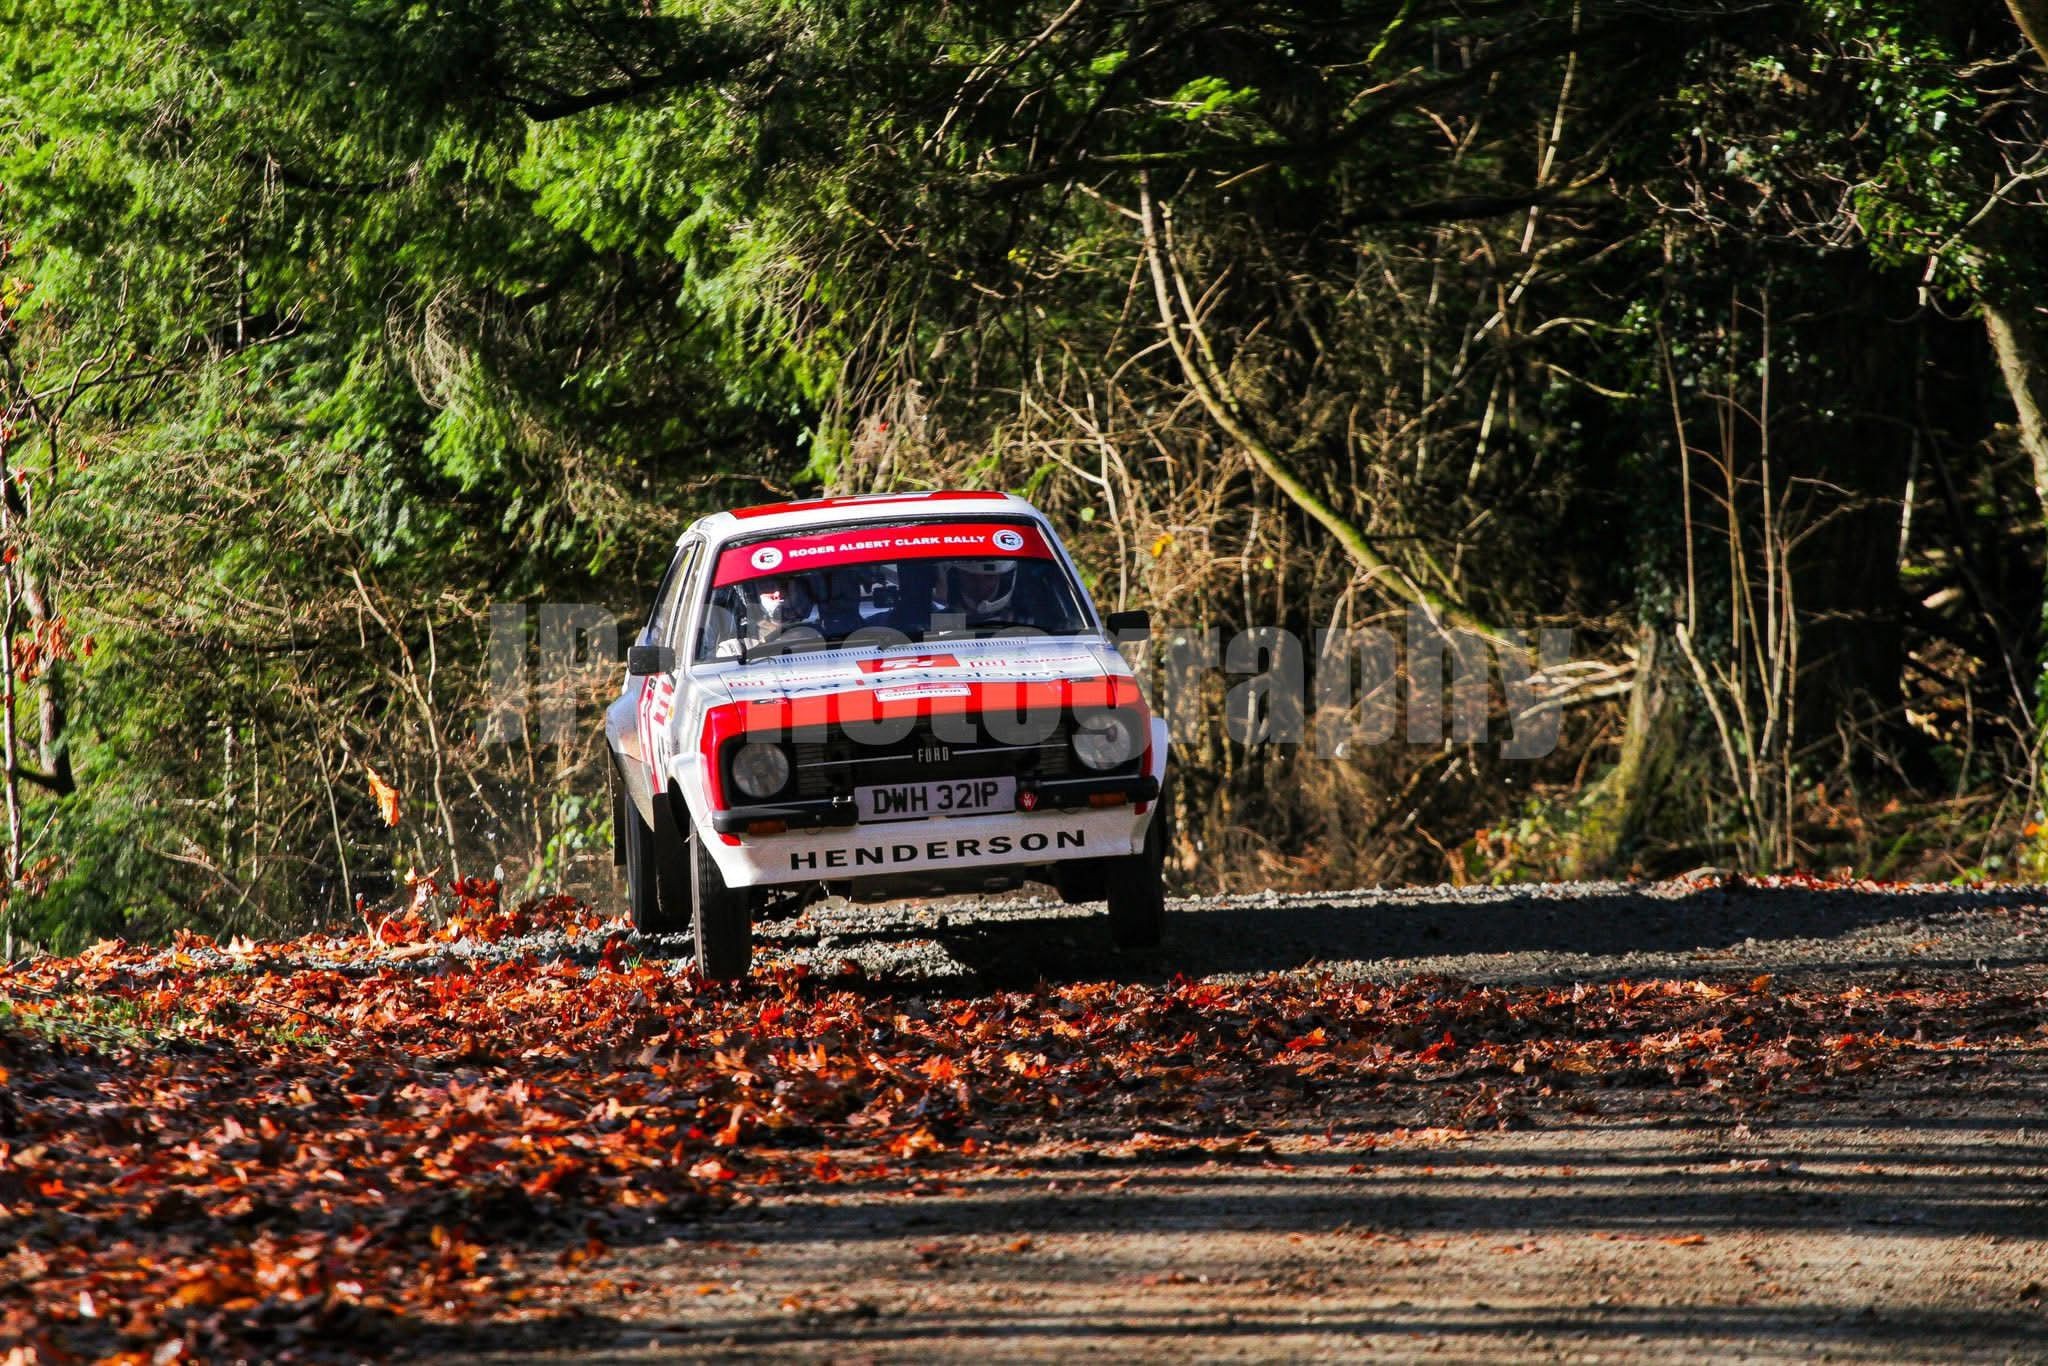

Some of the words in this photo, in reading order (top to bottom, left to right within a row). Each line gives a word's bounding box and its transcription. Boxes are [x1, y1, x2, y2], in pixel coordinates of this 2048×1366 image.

[788, 545, 835, 558] ROGER
[839, 539, 890, 551] ALBERT
[895, 536, 940, 546] CLARK
[944, 535, 986, 544] RALLY
[918, 746, 949, 763] FORD
[872, 785, 929, 815] DWH
[936, 780, 999, 810] 321P
[790, 829, 1086, 870] HENDERSON
